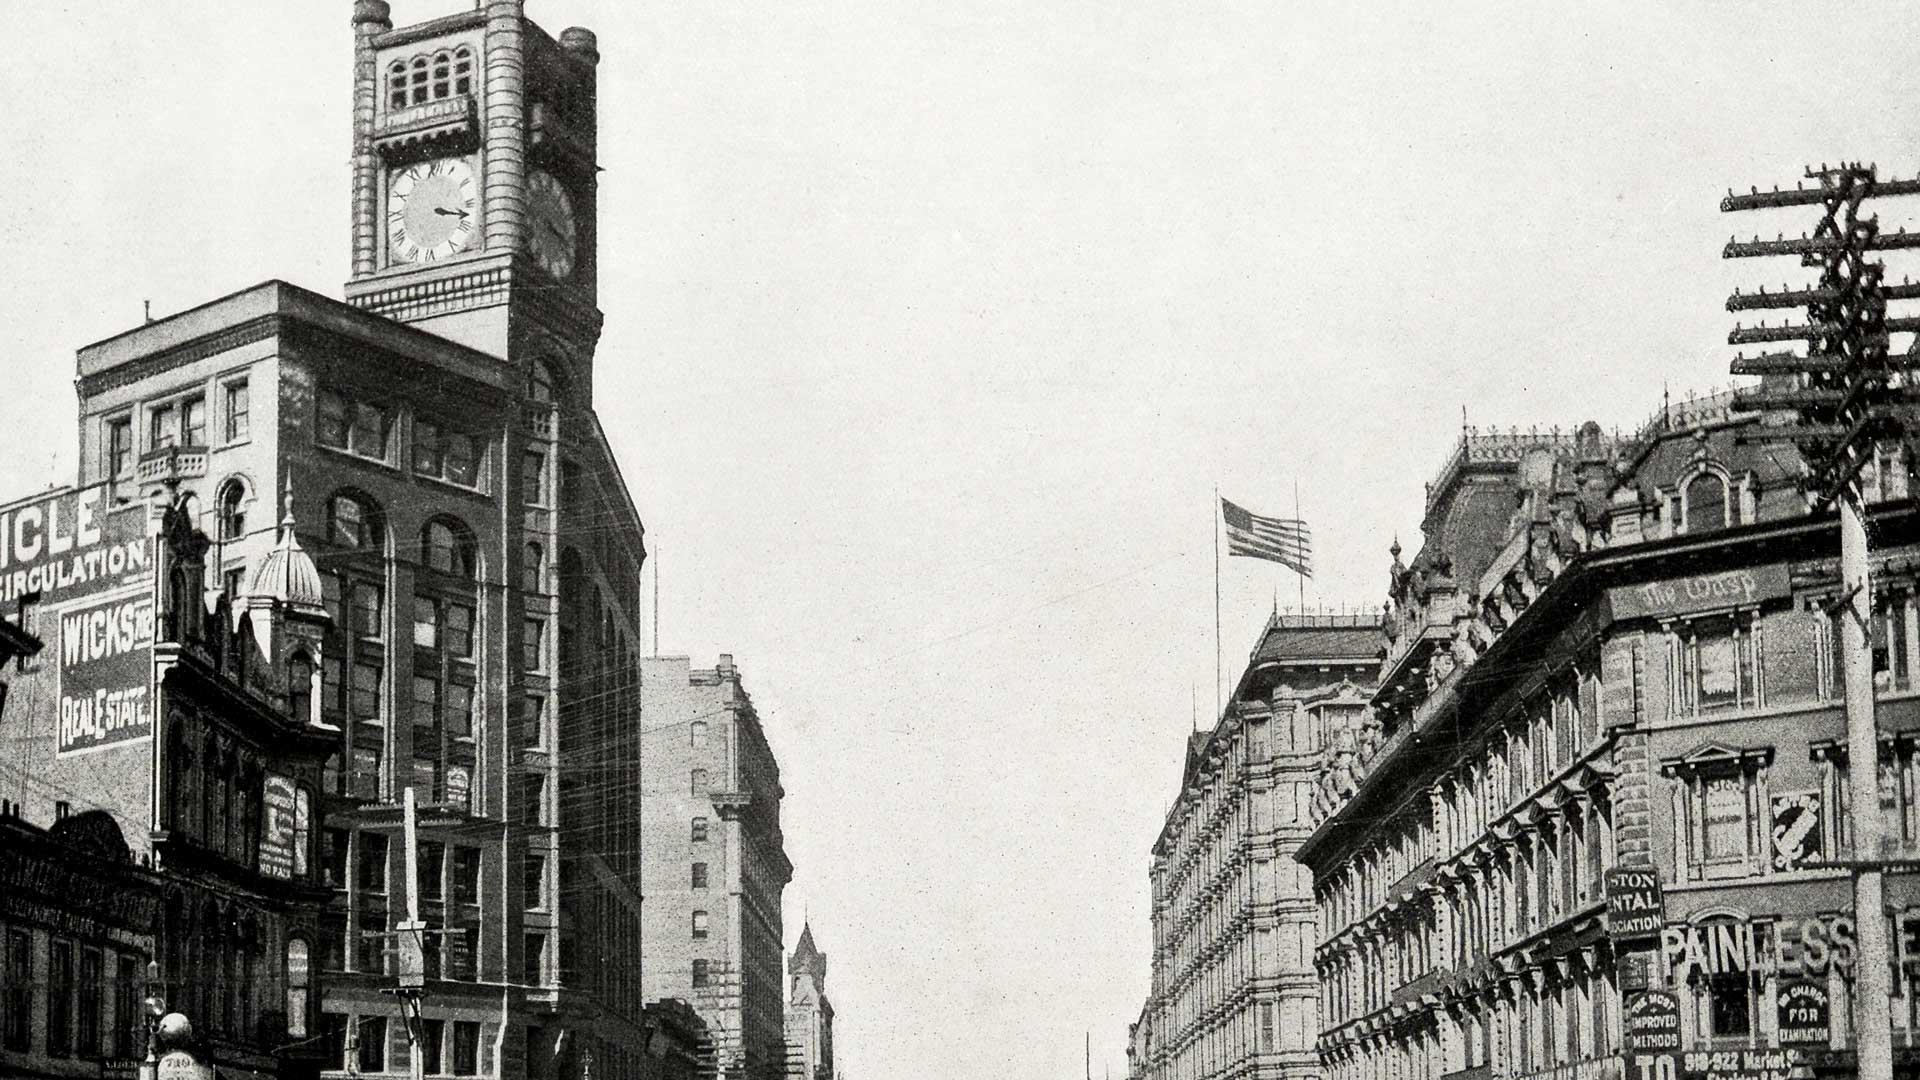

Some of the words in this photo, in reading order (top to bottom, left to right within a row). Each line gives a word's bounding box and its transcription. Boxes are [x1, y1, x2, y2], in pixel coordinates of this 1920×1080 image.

[0, 486, 102, 569] ICLE
[0, 539, 152, 602] IRCULATION.
[1684, 572, 1756, 604] Wasp
[63, 602, 135, 667] WICKS
[61, 695, 96, 747] REAL
[1606, 873, 1656, 888] STON
[1607, 890, 1660, 912] NTAL
[1661, 917, 1857, 977] PAINLESS
[1631, 1014, 1677, 1029] IMPROVED
[1789, 1007, 1818, 1023] FOR
[1632, 1033, 1678, 1048] METHODS
[1743, 1050, 1786, 1070] Market
